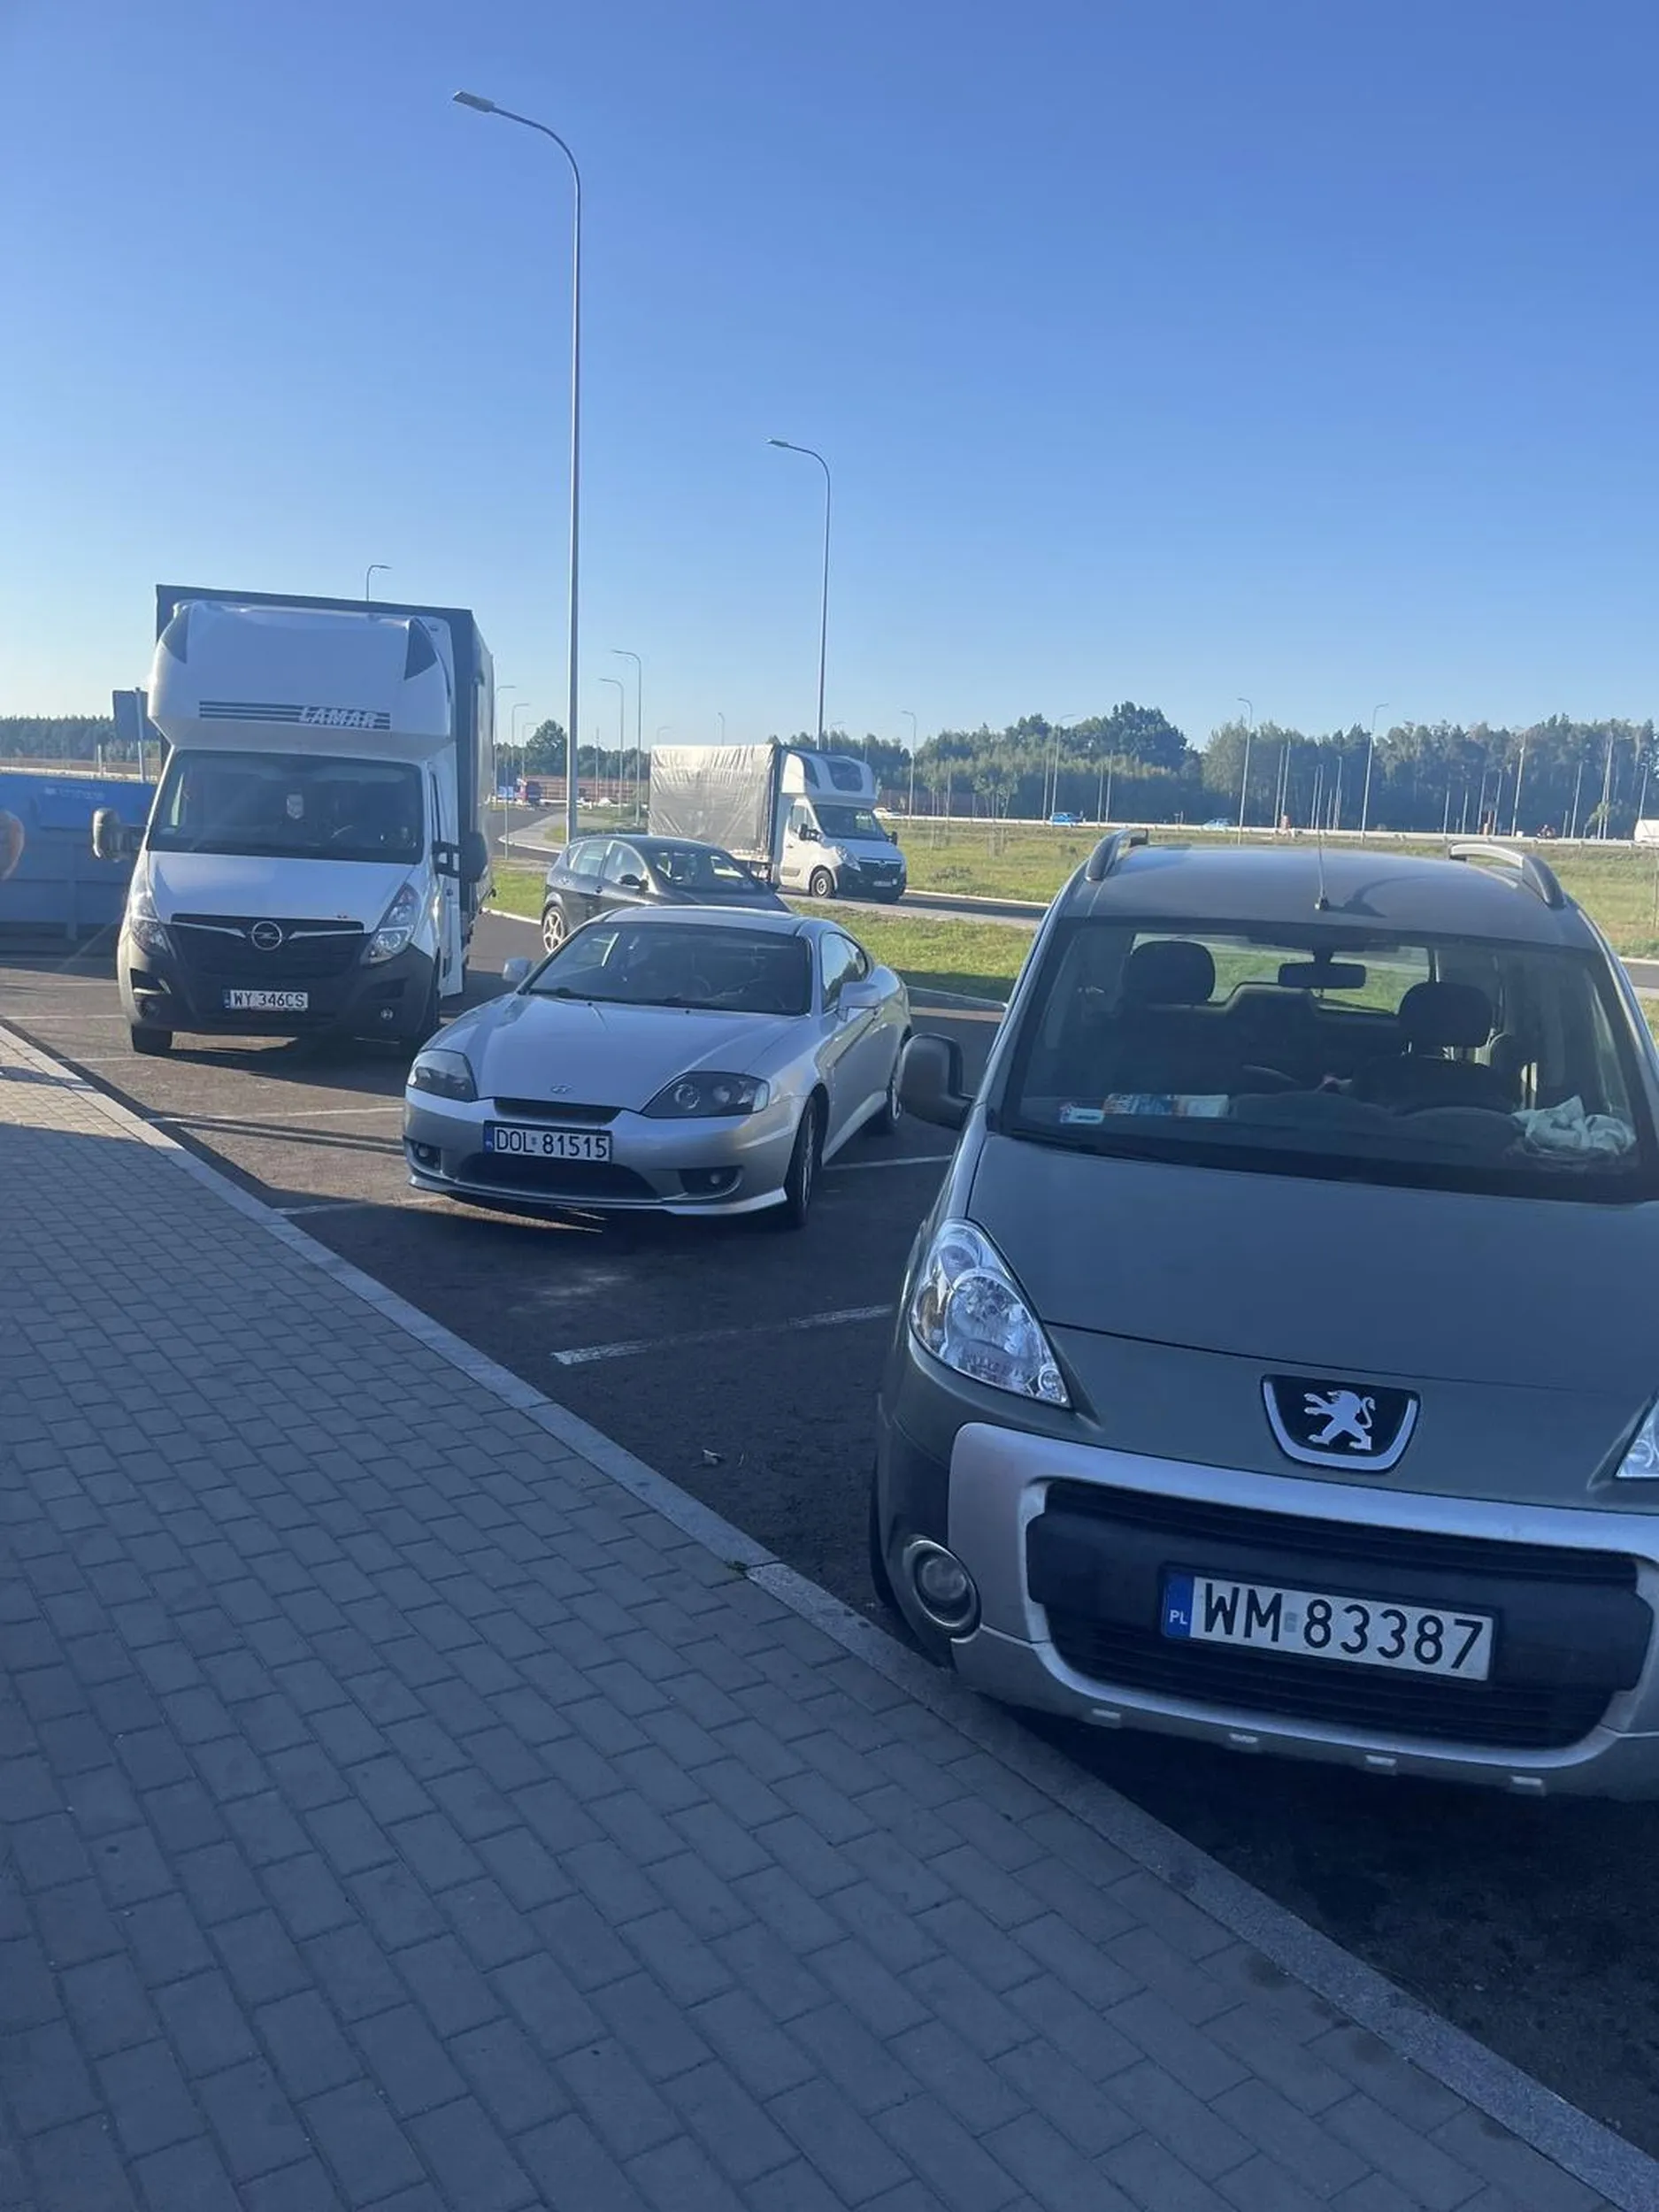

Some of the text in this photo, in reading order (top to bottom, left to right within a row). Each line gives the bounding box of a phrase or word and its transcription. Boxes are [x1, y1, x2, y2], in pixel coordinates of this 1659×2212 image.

[299, 707, 378, 728] LAMAR
[234, 992, 304, 1008] WY 346CS
[496, 1129, 608, 1158] DOL 81515
[1169, 1583, 1484, 1670] PL WM 83387
